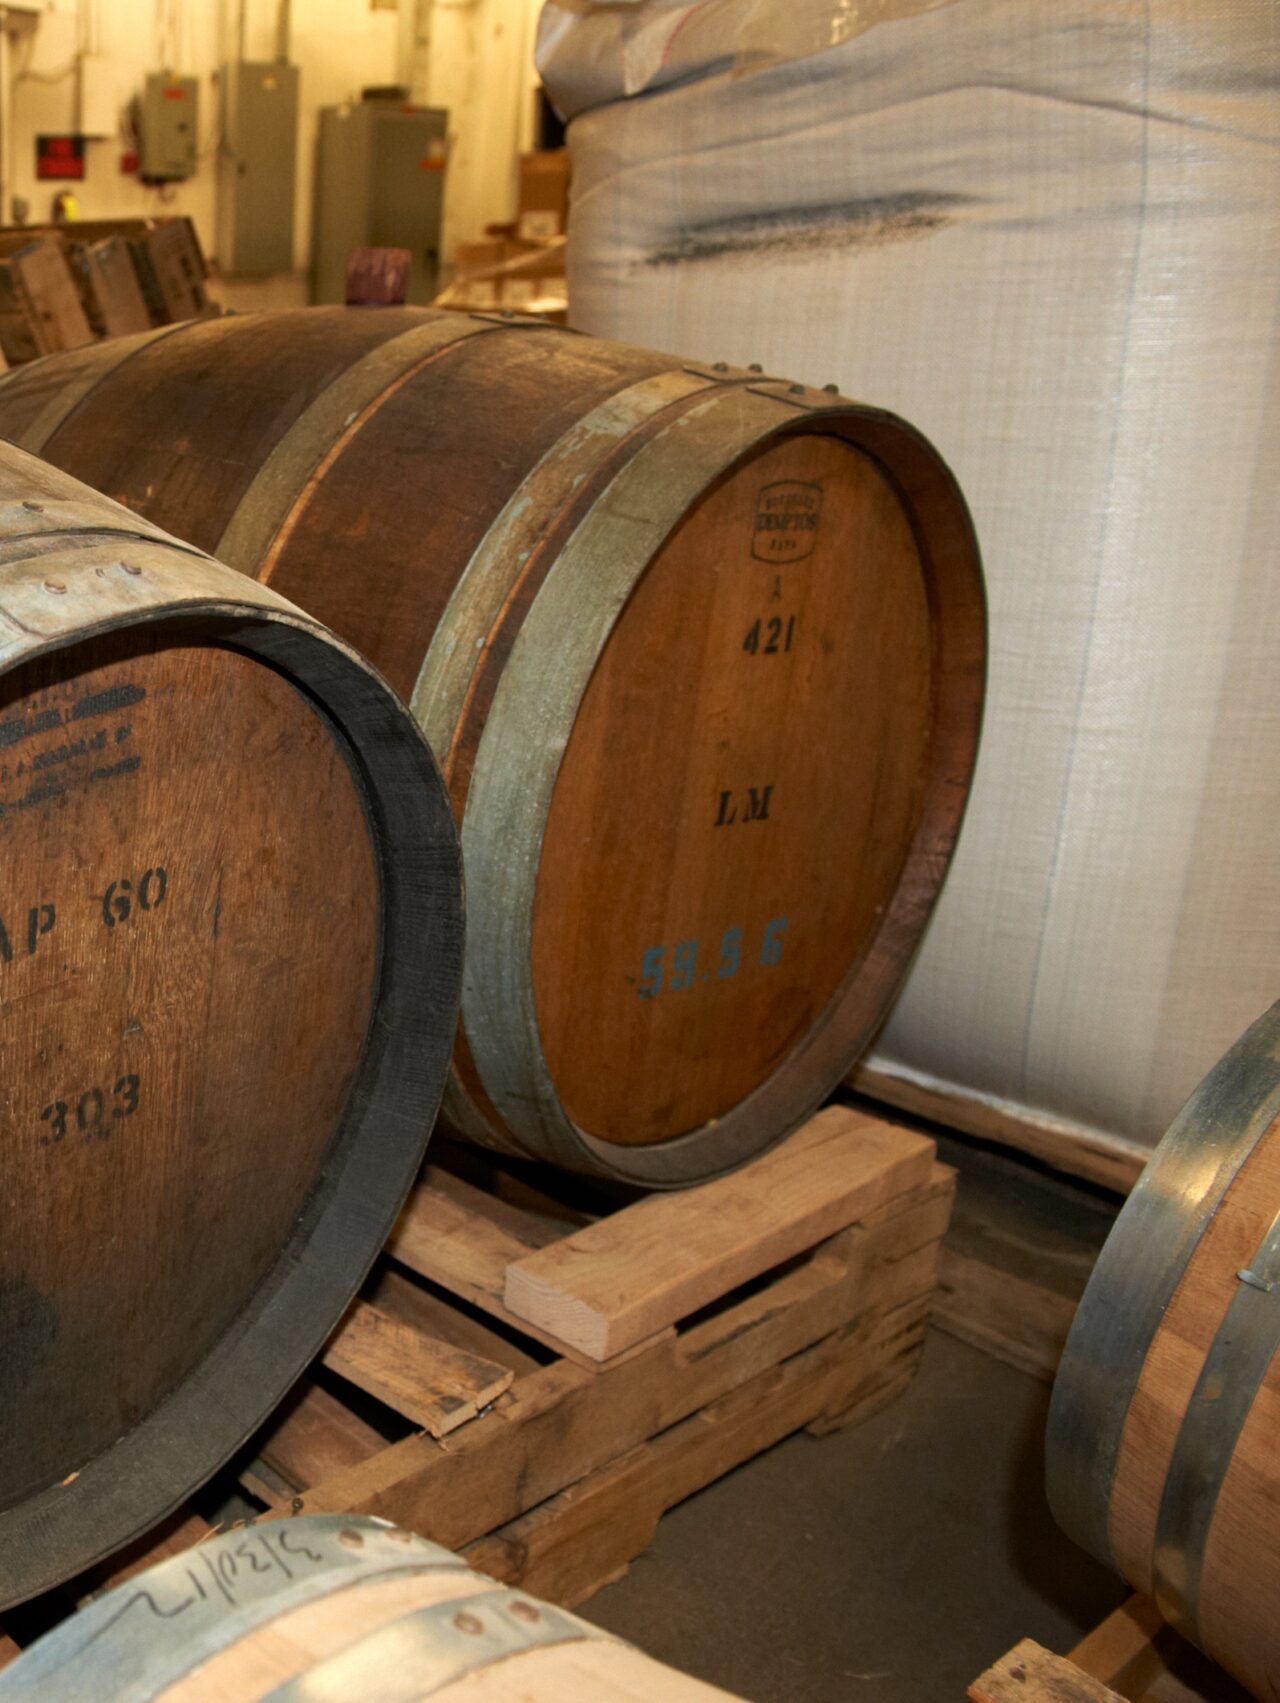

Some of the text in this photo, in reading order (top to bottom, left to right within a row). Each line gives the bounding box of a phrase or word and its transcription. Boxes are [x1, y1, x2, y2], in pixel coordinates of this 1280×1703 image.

[742, 616, 796, 656] 421
[101, 866, 169, 928] 60
[38, 1073, 142, 1148] 303
[70, 1527, 323, 1664] 3/30/12
